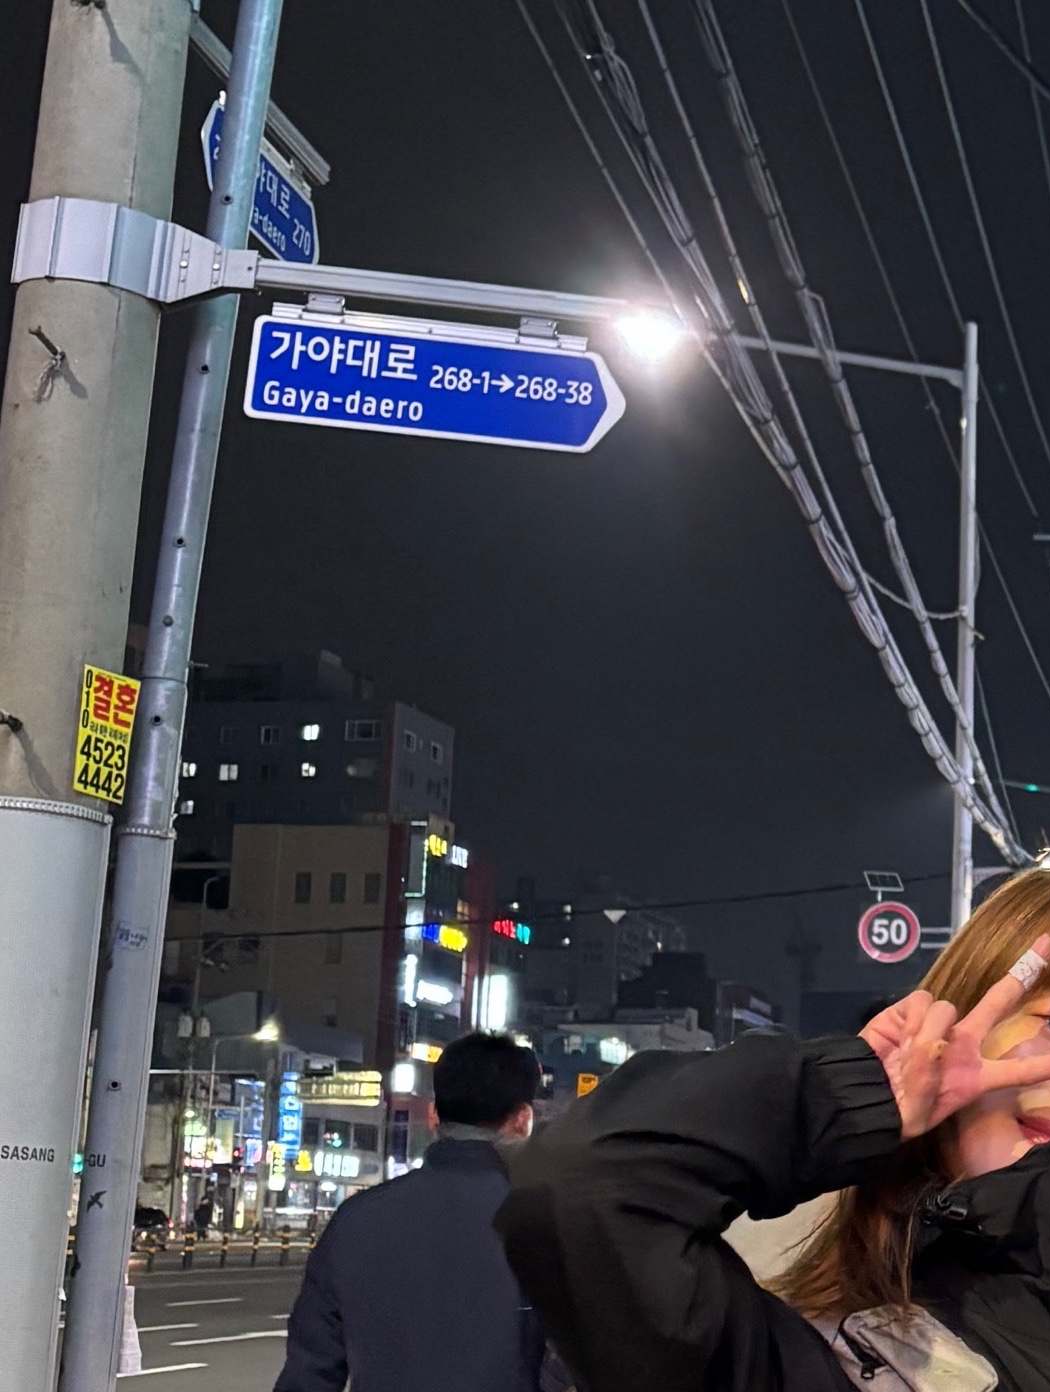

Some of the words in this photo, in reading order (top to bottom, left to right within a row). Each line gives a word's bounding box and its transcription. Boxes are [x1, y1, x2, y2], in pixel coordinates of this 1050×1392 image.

[292, 218, 312, 257] 270
[269, 331, 418, 381] 가야대로
[262, 380, 423, 422] Gaya-daero
[81, 669, 93, 728] 010
[92, 674, 138, 729] 결혼
[80, 734, 126, 772] 4523
[77, 762, 125, 800] 4442
[871, 918, 908, 945] 50
[0, 1145, 55, 1163] SASANG
